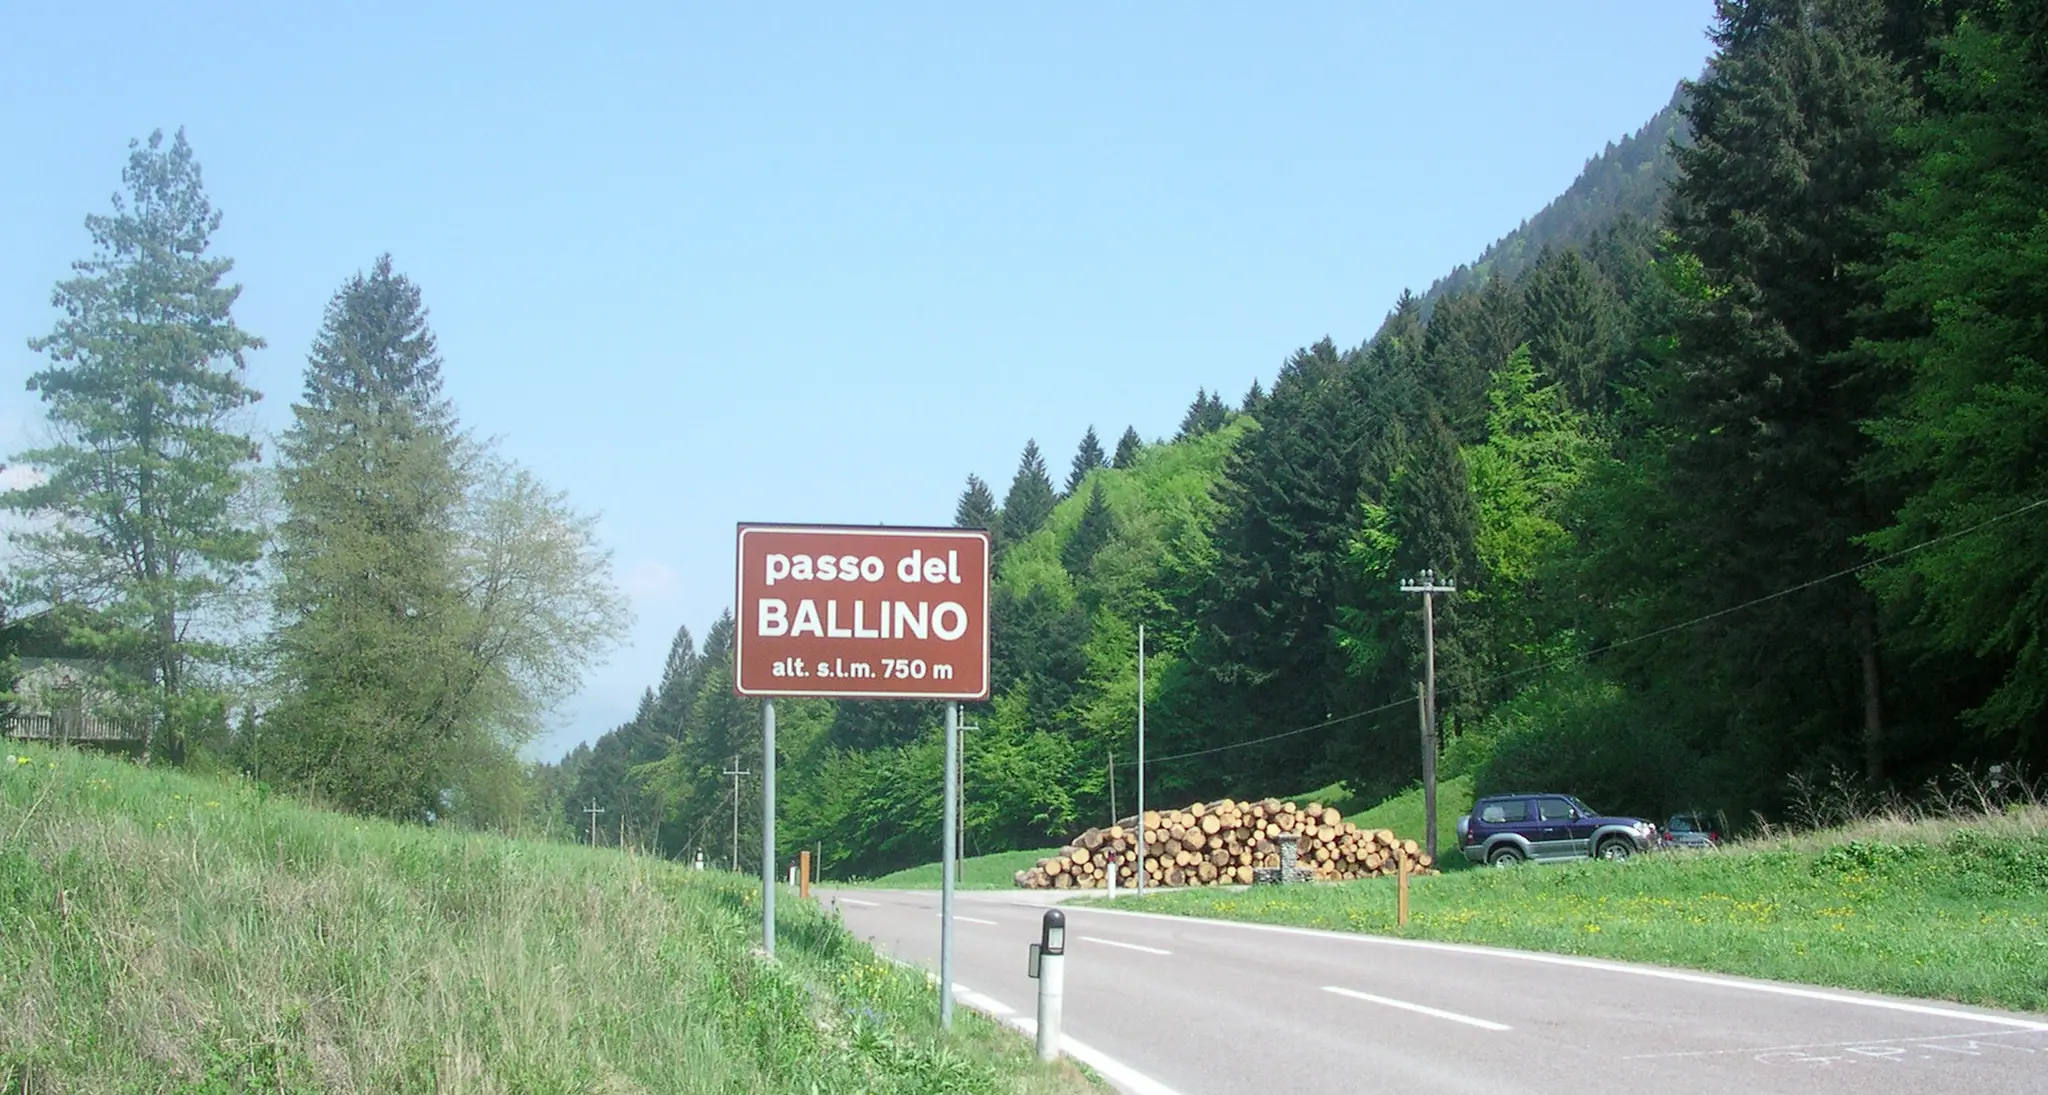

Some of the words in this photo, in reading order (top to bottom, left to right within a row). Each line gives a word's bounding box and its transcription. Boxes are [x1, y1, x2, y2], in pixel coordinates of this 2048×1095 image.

[765, 553, 885, 586] passo
[896, 549, 961, 584] del
[758, 598, 968, 641] BALLINO
[772, 657, 810, 677] alt.
[816, 658, 876, 678] s.l.m.
[881, 659, 926, 679] 750
[932, 664, 953, 680] m
